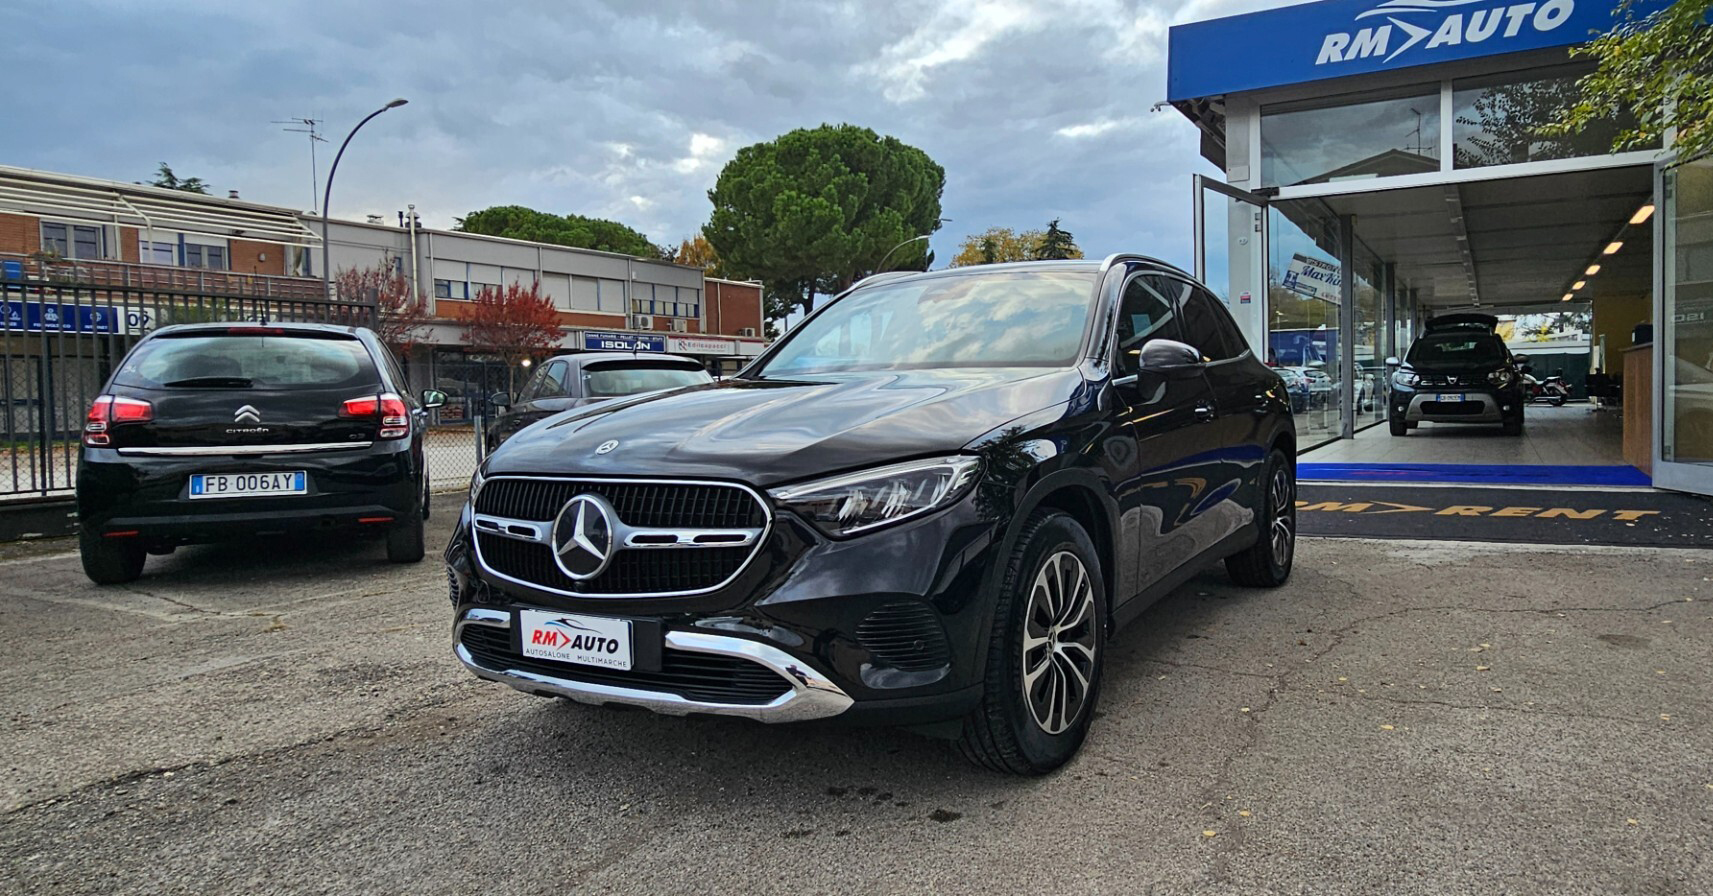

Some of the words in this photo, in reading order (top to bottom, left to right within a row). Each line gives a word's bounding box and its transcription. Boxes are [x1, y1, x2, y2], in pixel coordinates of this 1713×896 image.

[1315, 25, 1392, 65] RM
[1425, 0, 1575, 49] AUTO
[205, 476, 228, 492] FB
[236, 474, 293, 491] 006AY
[1434, 505, 1661, 521] RENT
[532, 629, 558, 646] RM
[571, 634, 619, 654] AUTO
[526, 649, 570, 659] AUTOSALONE
[577, 655, 626, 667] MULTIMARCHE
